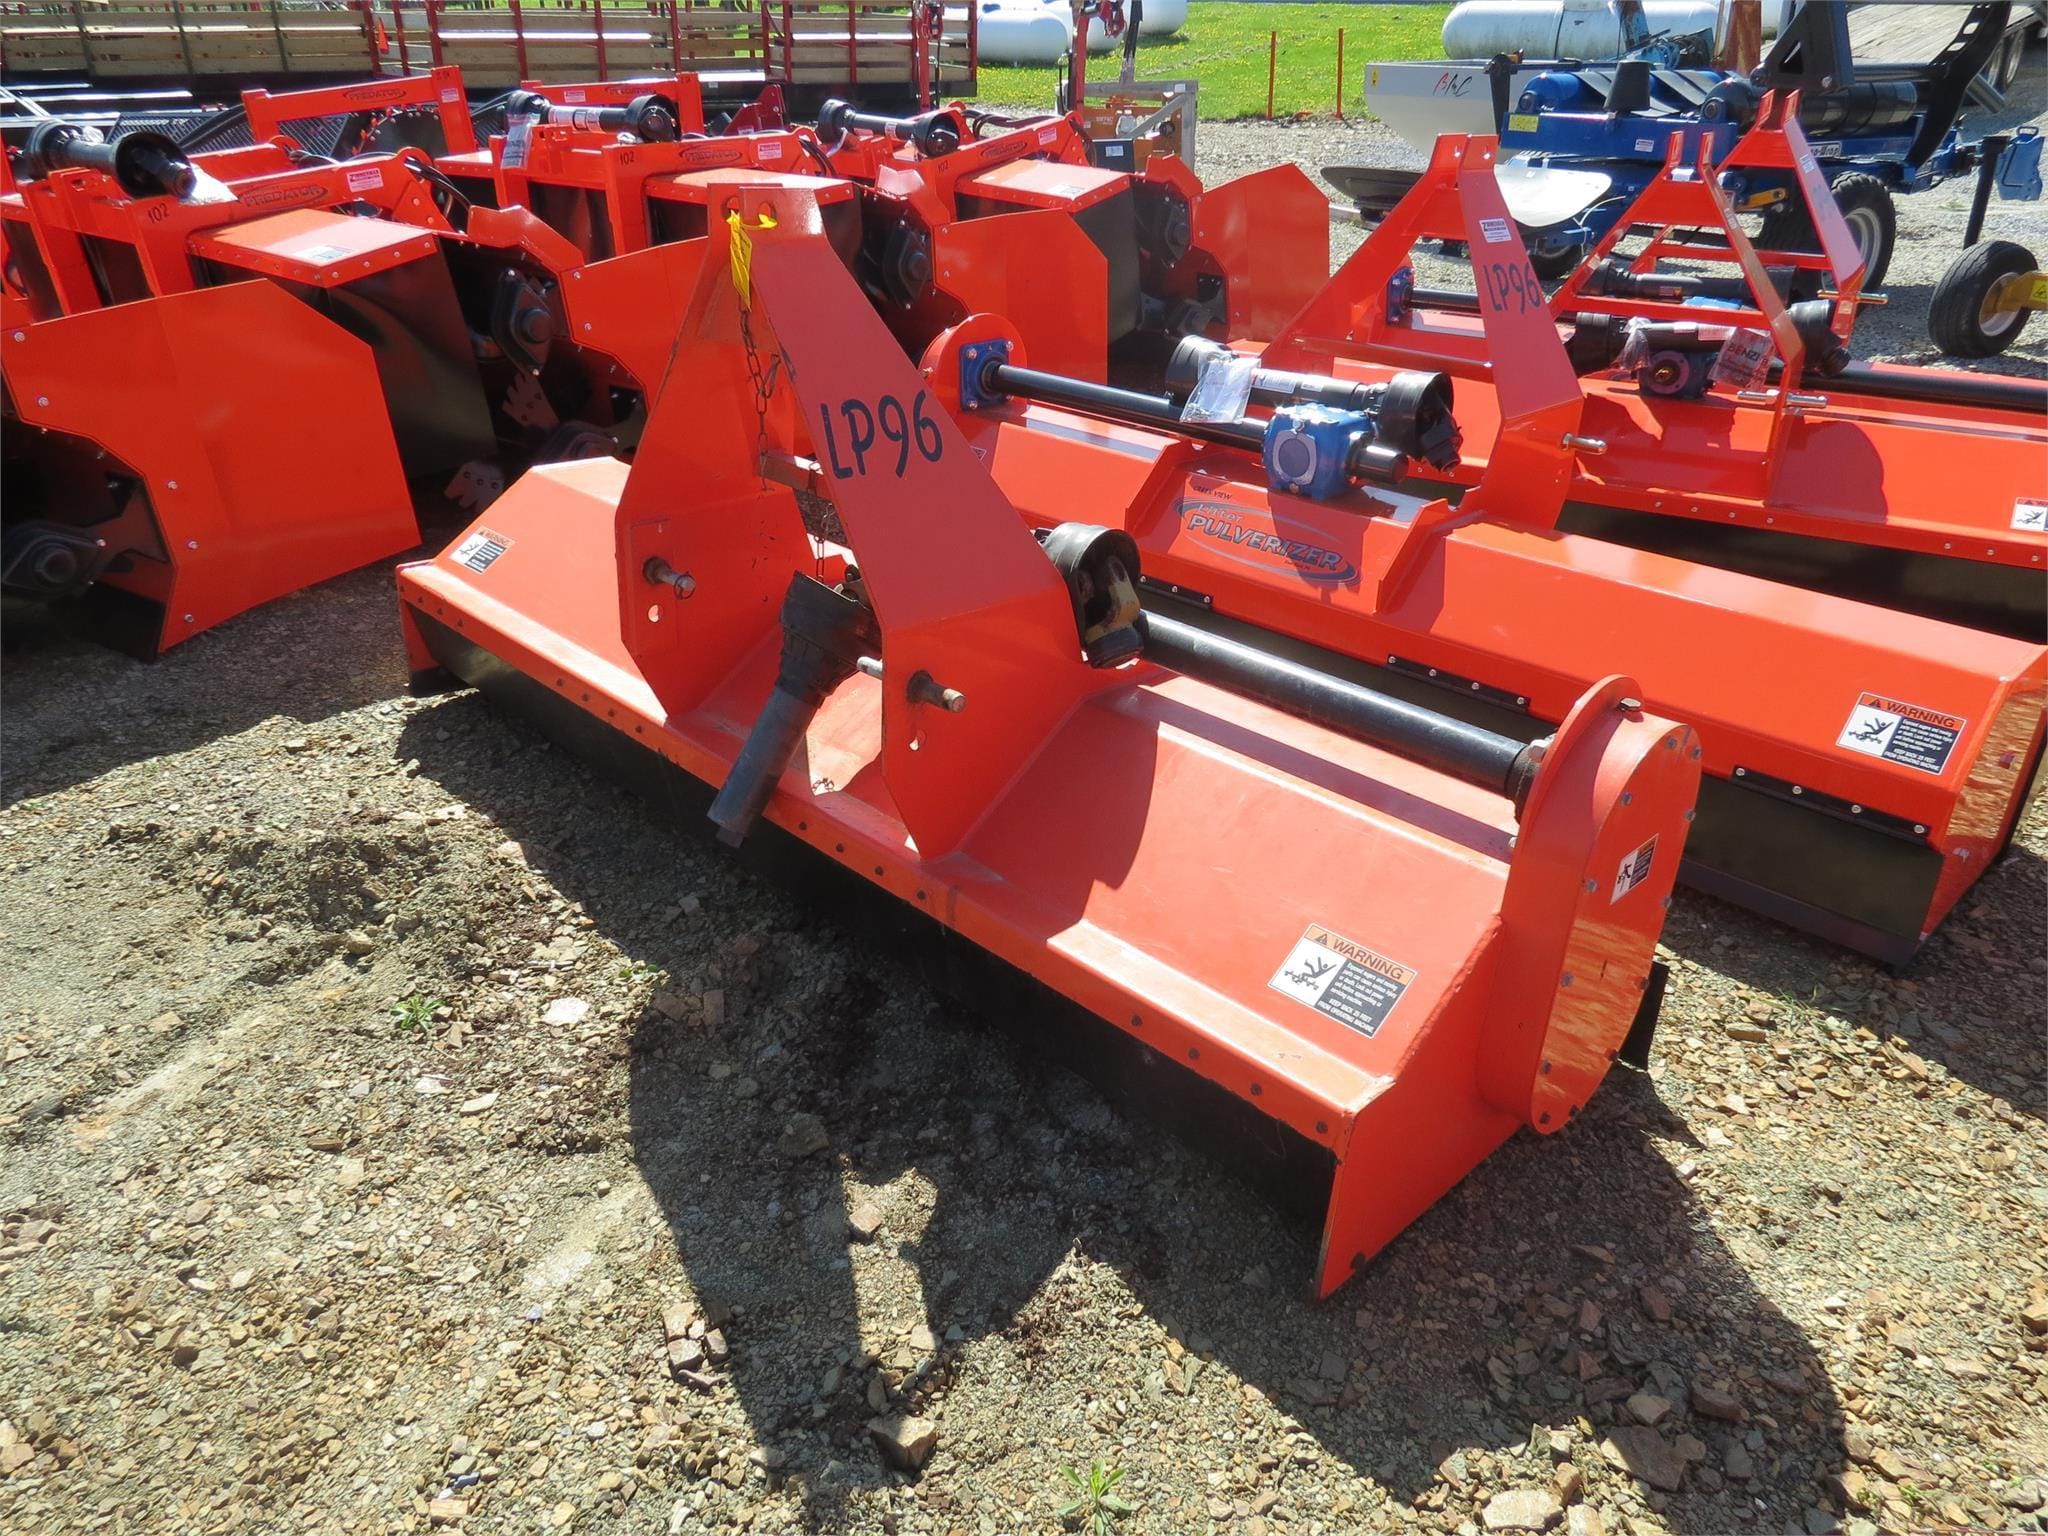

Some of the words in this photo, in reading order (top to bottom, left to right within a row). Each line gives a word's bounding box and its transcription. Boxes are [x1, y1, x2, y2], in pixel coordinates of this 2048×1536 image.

[619, 150, 635, 166] 102
[148, 202, 169, 224] 102
[244, 185, 322, 208] PREDATOR
[1483, 263, 1541, 315] LP96
[820, 389, 943, 480] LP96
[1187, 514, 1343, 570] PULVERIZER
[1885, 702, 1956, 727] WARNING
[1330, 938, 1405, 980] WARNING
